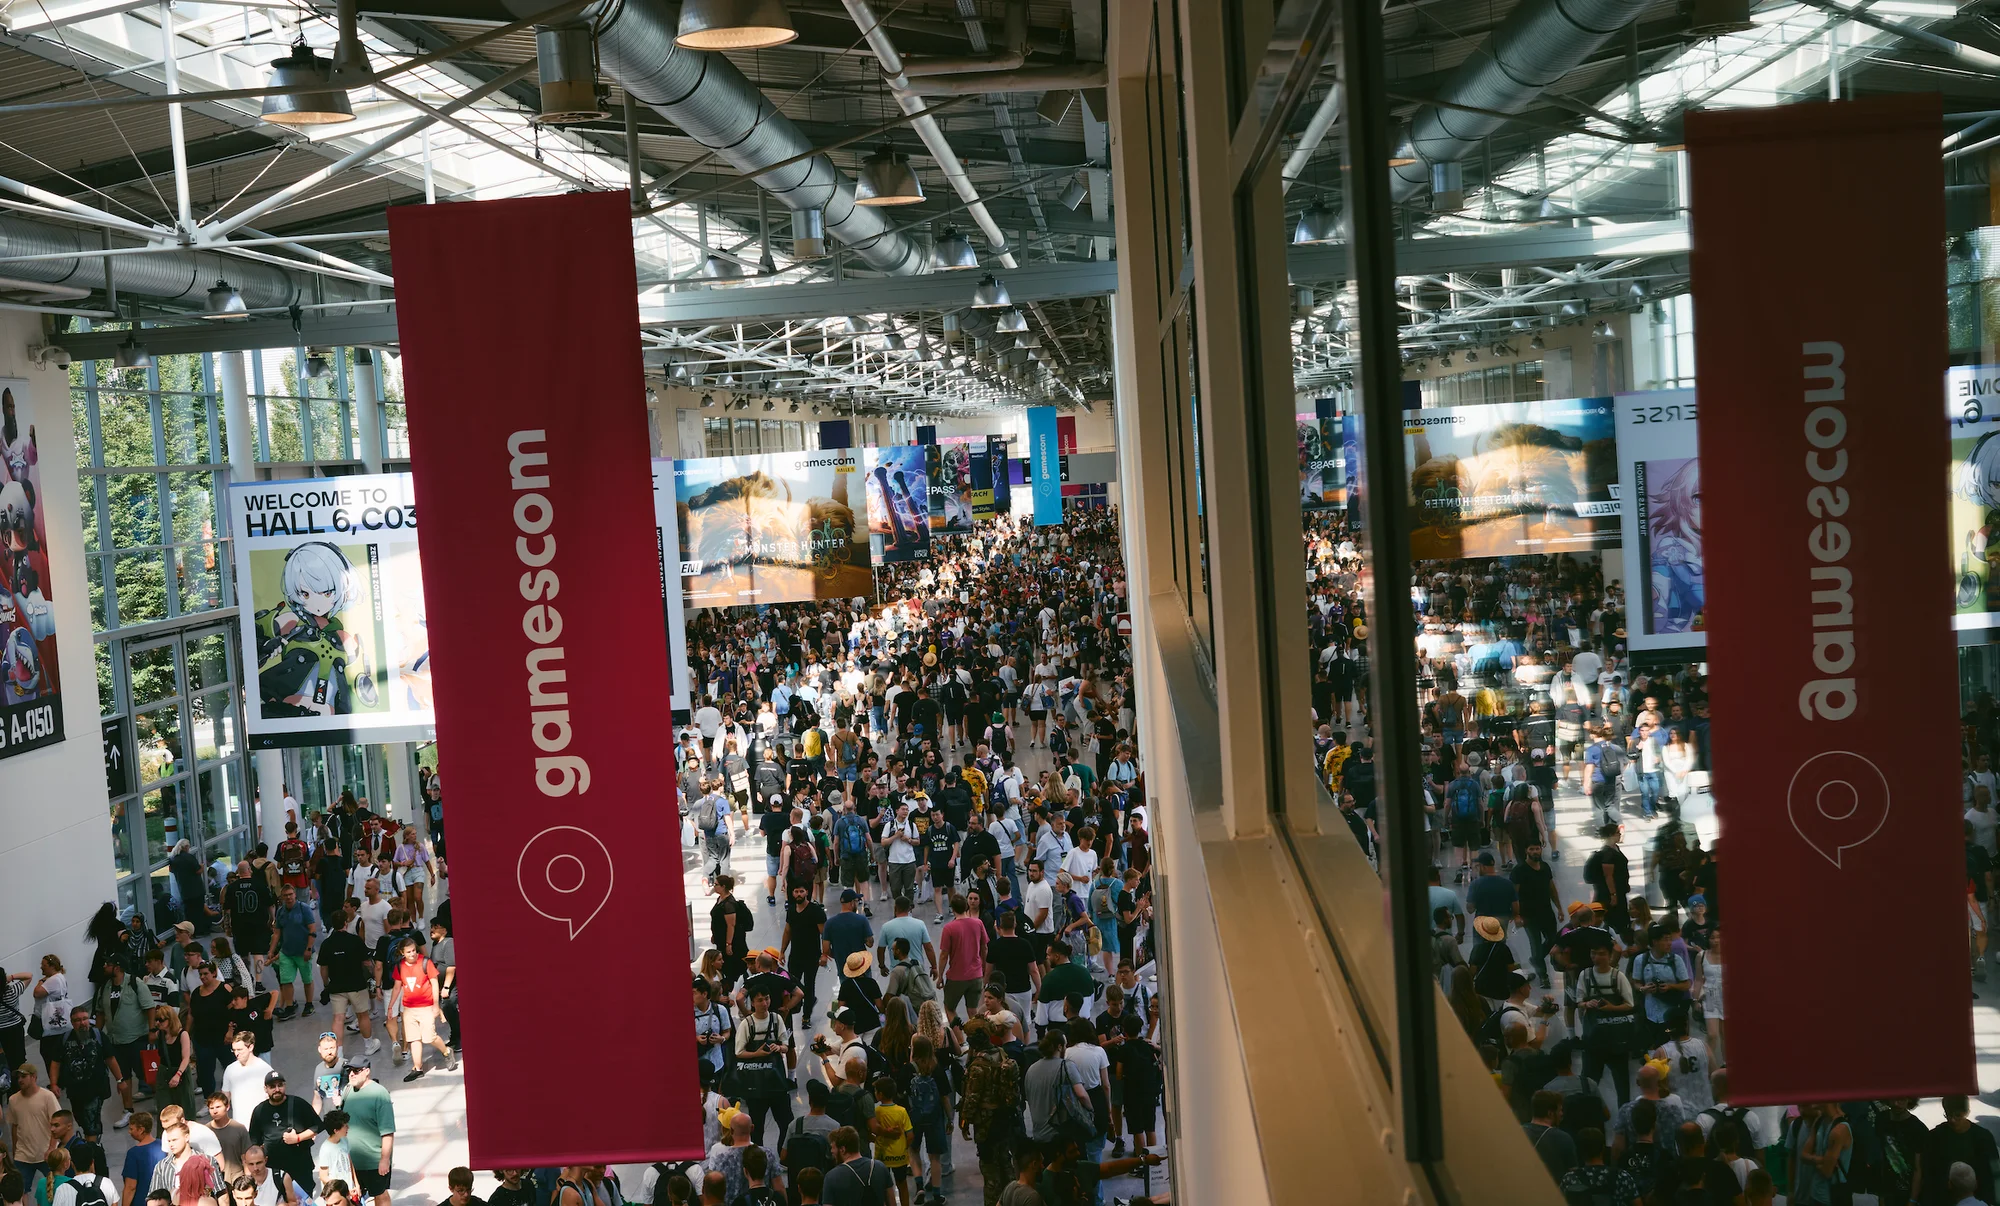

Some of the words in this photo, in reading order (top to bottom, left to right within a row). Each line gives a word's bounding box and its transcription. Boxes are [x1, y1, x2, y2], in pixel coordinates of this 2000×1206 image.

[795, 457, 855, 471] gamescom
[1040, 434, 1050, 480] gamescom
[244, 490, 352, 511] WELCOME
[359, 488, 387, 504] TO
[931, 485, 955, 495] PASS
[246, 510, 325, 537] HALL
[744, 543, 798, 554] MONSTER
[801, 538, 845, 551] HUNTER
[370, 546, 379, 579] ZENLESS
[681, 563, 699, 574] EN!
[374, 601, 382, 621] ZERO
[507, 429, 590, 798] gamescom
[11, 704, 54, 746] A-050
[235, 890, 258, 914] 10
[881, 1154, 907, 1162] Lenovo
